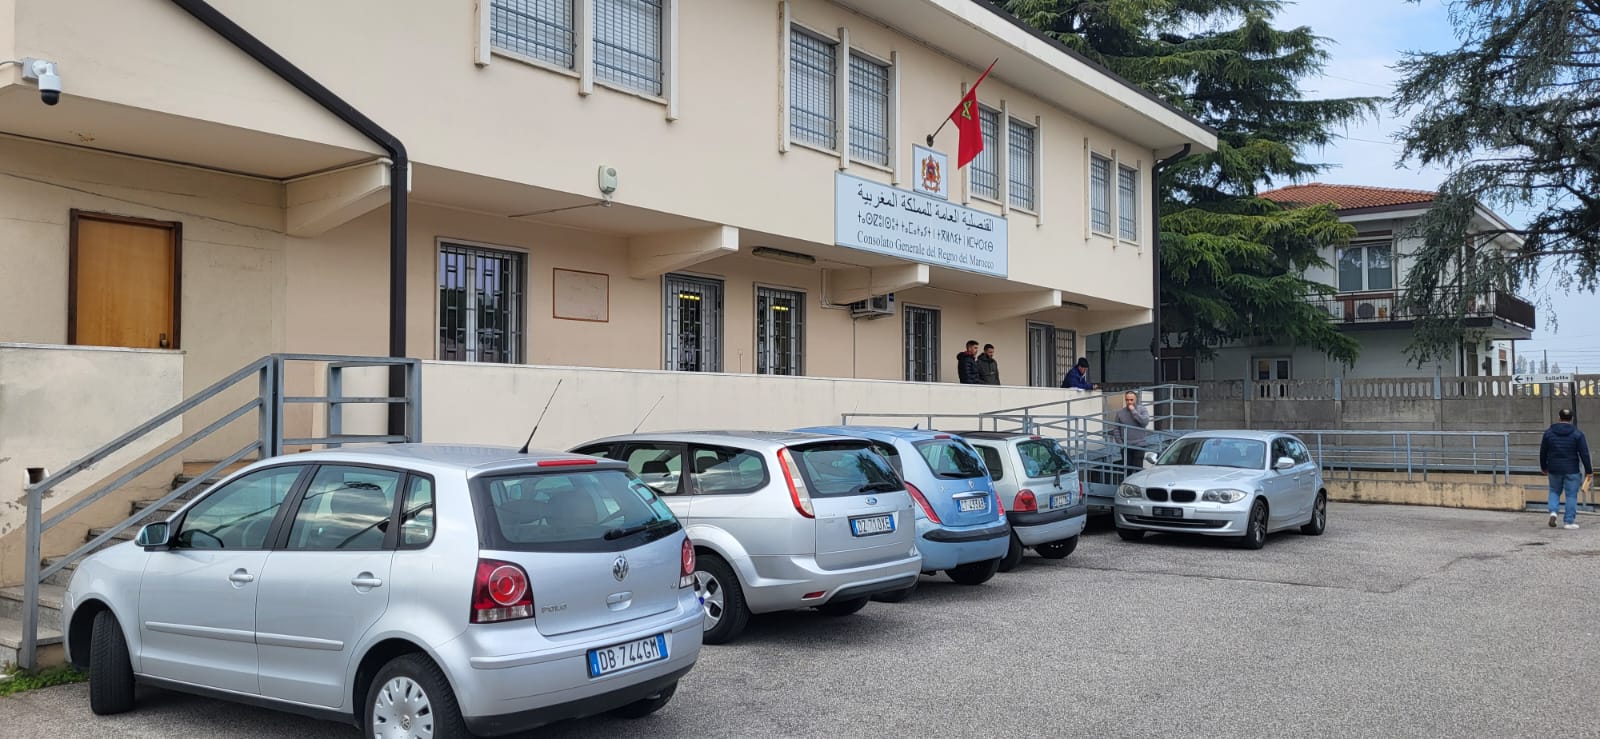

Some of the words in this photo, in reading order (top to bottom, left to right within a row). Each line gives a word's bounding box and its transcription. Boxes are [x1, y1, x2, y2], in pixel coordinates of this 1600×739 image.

[857, 183, 898, 209] المغربية
[901, 195, 932, 217] للمملكة
[935, 204, 959, 223] العامة
[961, 211, 994, 233] القنصلية
[857, 230, 894, 249] Consolato
[895, 238, 925, 256] Generale
[926, 244, 936, 257] del
[938, 247, 958, 264] Regno
[969, 254, 995, 270] Marocco
[856, 519, 867, 533] DZ
[598, 649, 617, 671] DB
[619, 635, 660, 667] 744GM
